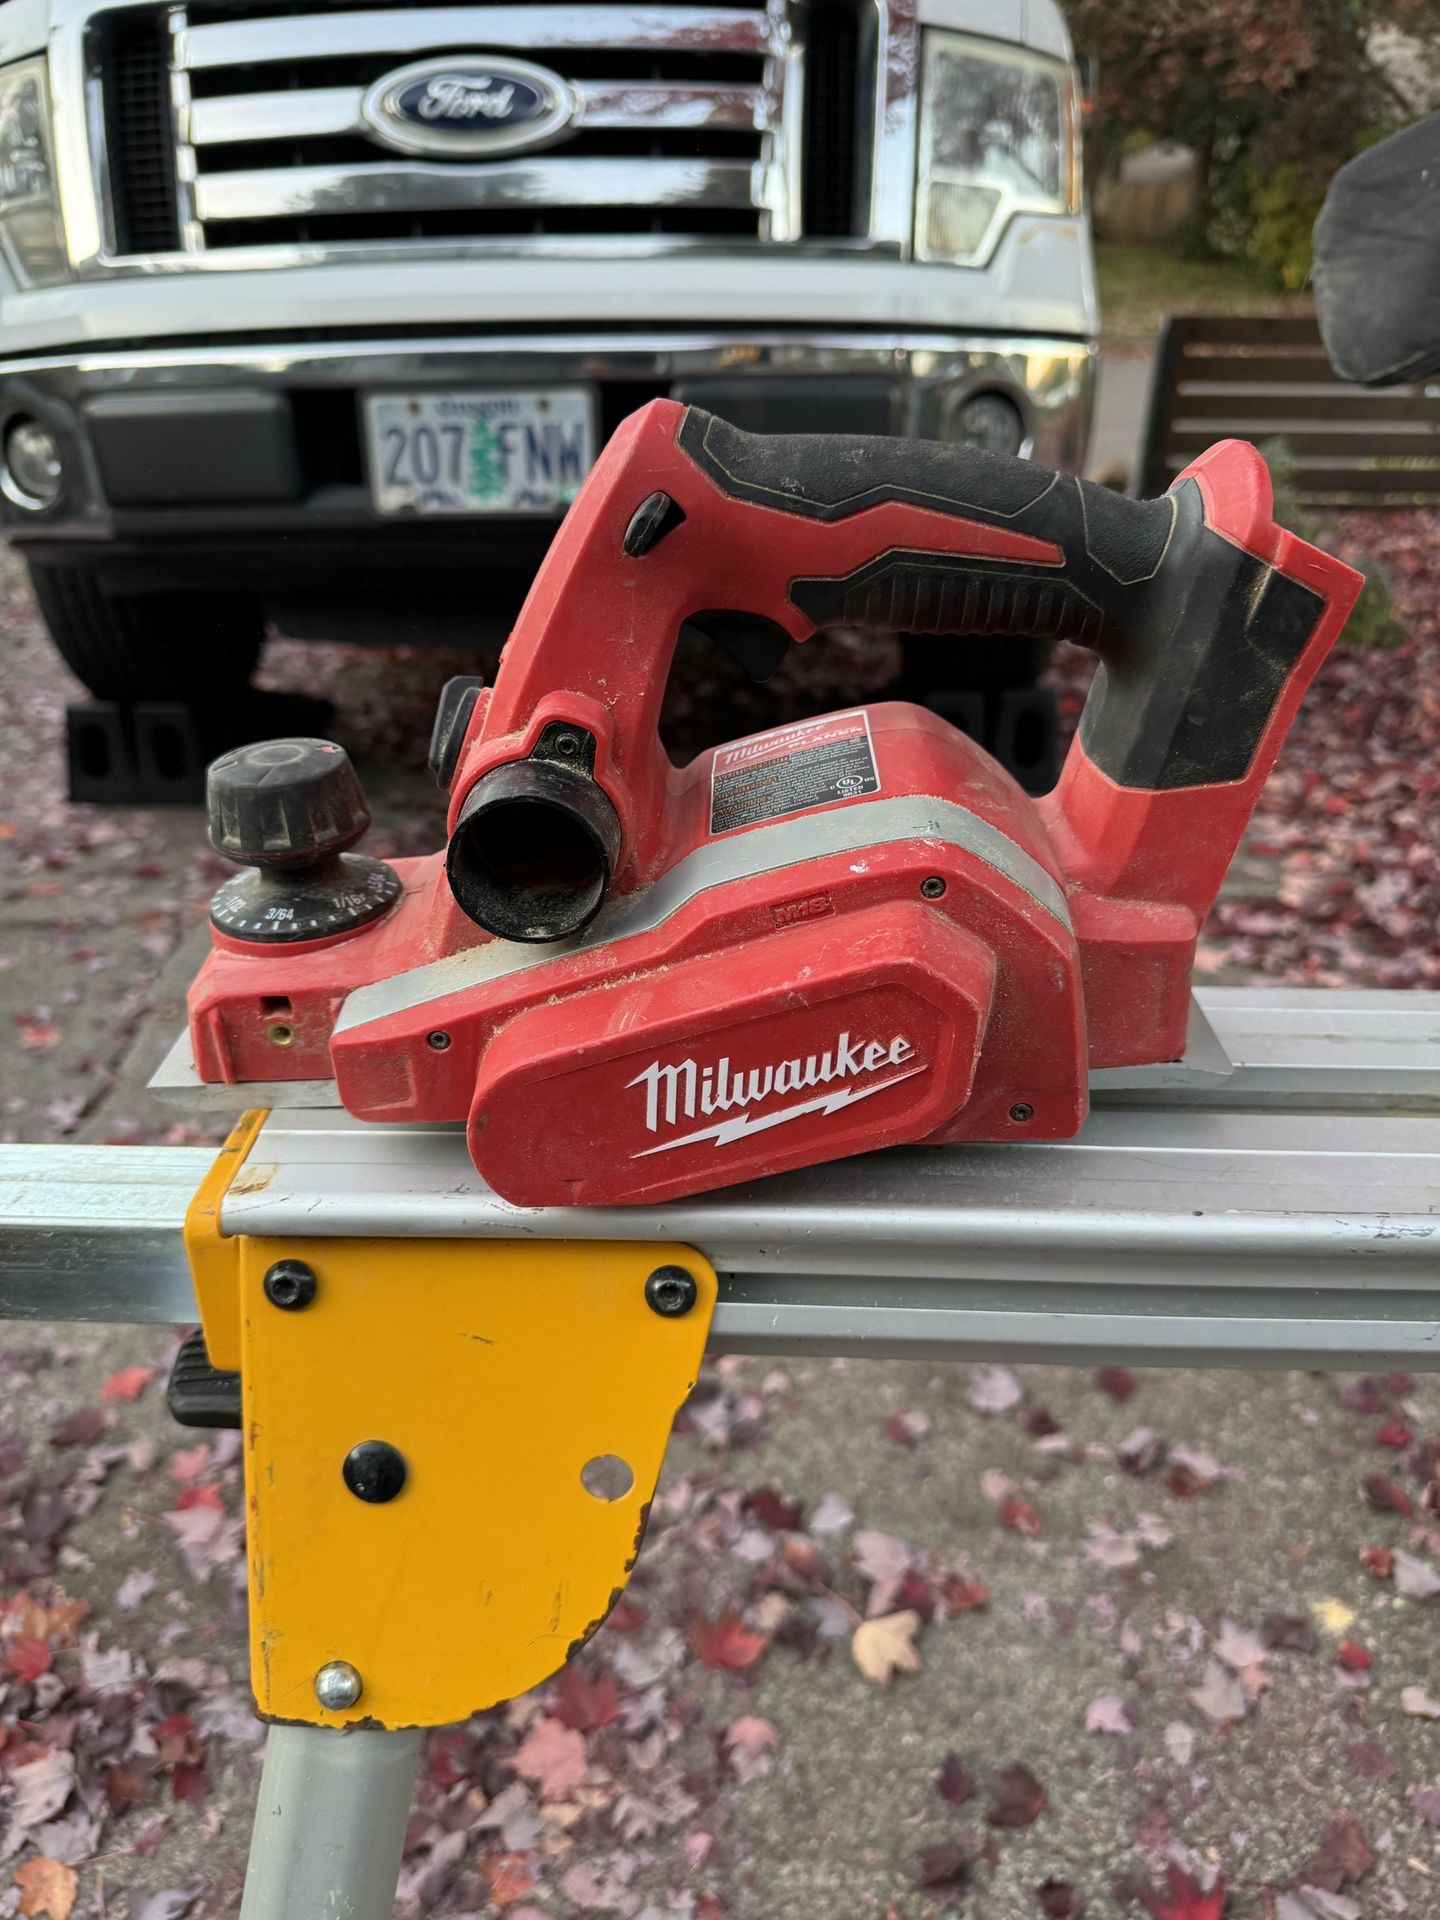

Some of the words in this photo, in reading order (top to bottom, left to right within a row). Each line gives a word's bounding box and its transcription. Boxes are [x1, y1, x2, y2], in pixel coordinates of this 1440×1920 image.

[418, 73, 516, 119] Ford
[382, 424, 465, 486] 207
[264, 907, 295, 920] 3/64
[624, 1031, 915, 1132] Milwaukee
